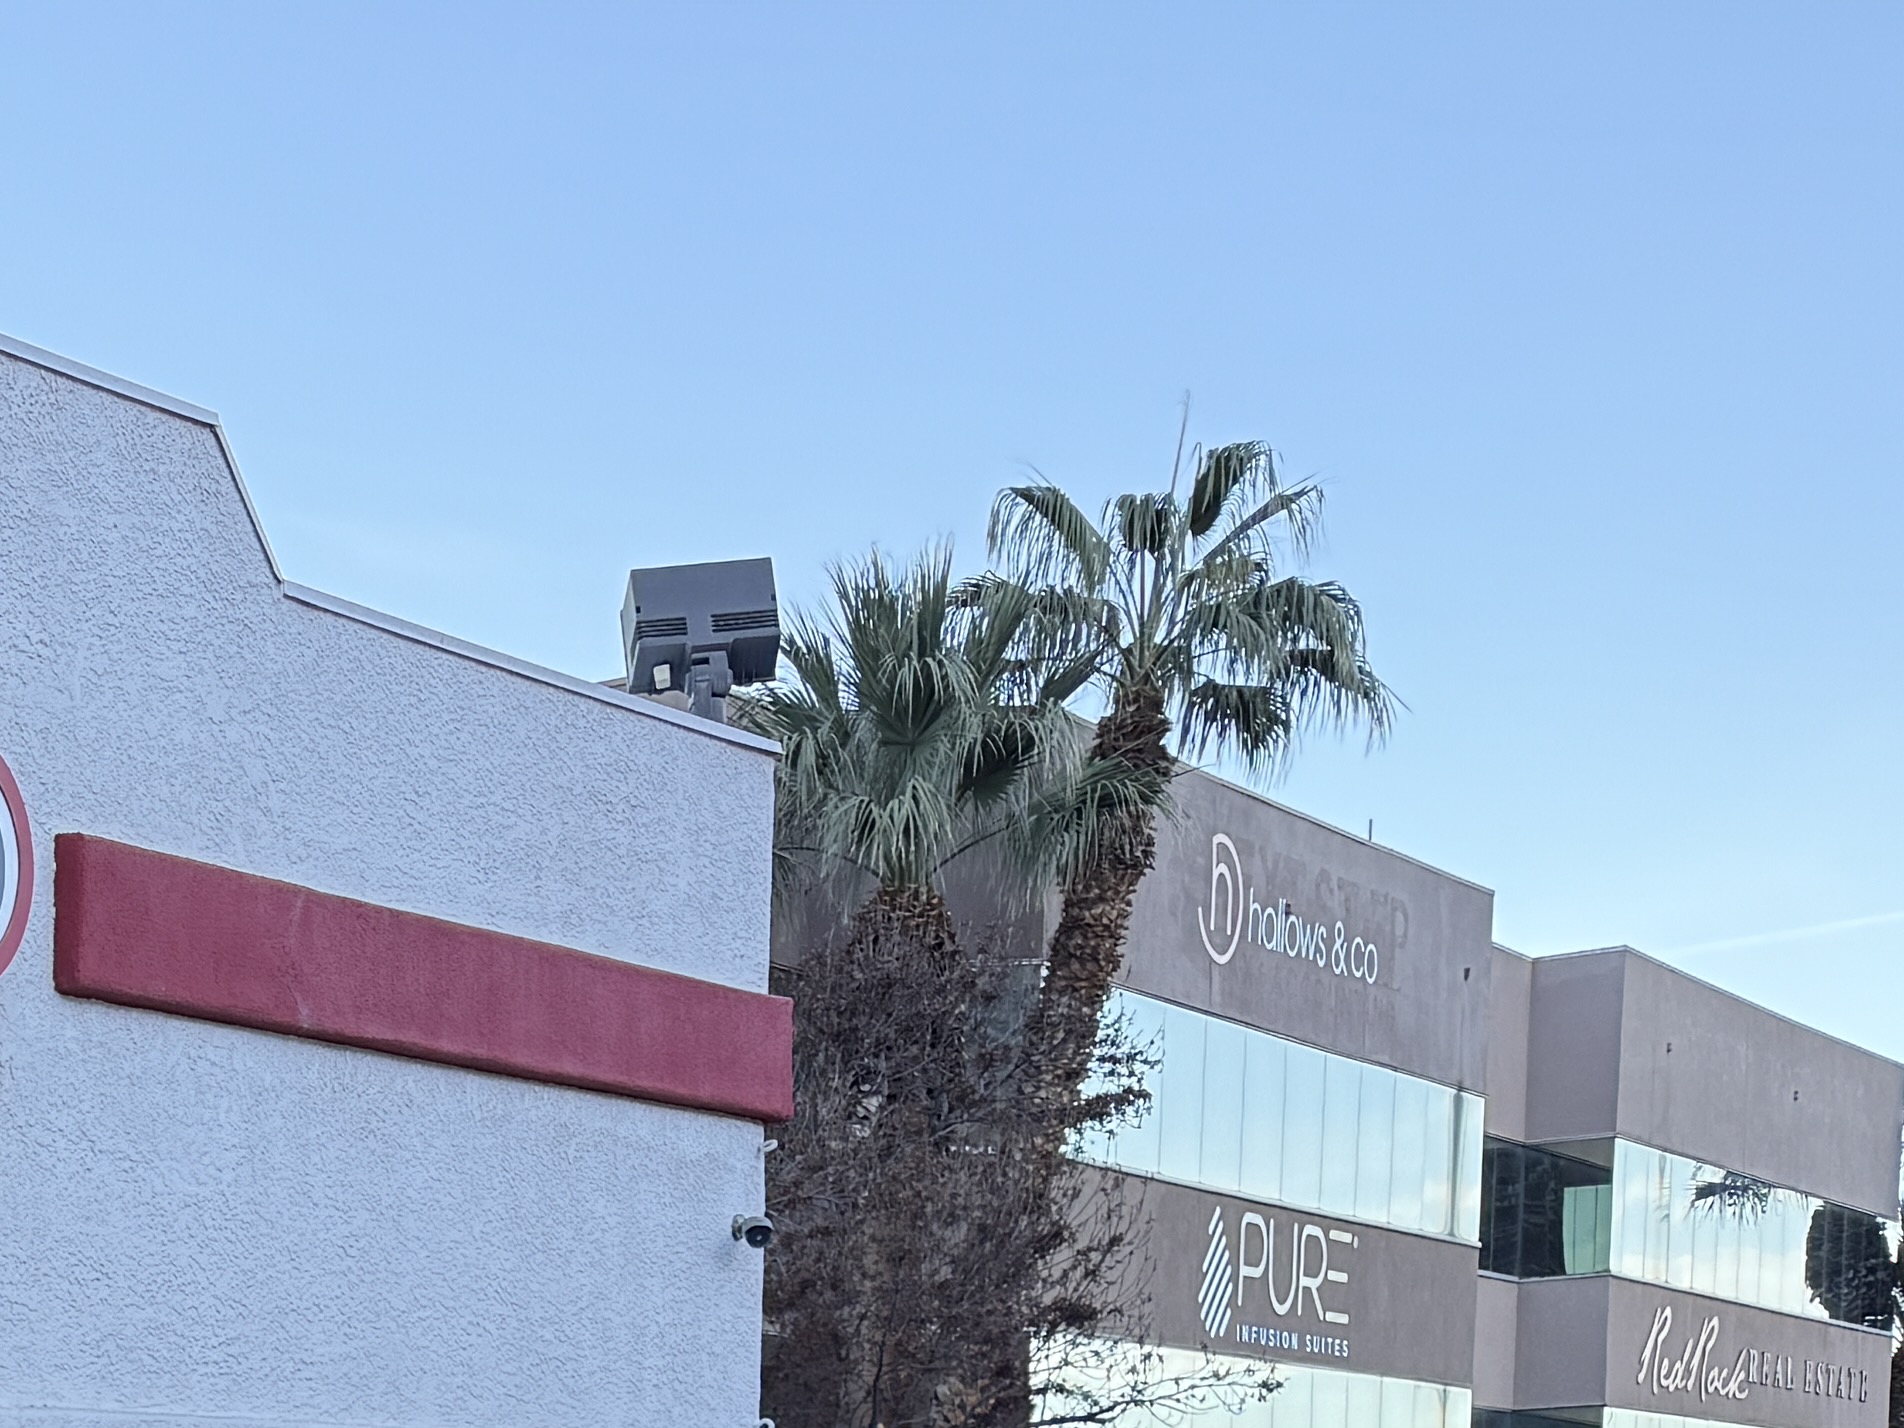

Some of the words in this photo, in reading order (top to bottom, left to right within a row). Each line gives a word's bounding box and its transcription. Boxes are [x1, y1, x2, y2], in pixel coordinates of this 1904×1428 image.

[1248, 886, 1327, 968] hallows
[1331, 920, 1348, 977] &
[1237, 1211, 1354, 1325] PURE
[1235, 1323, 1299, 1350] INFUSION
[1305, 1333, 1349, 1358] SUITES
[1747, 1348, 1795, 1391] REAL
[1803, 1359, 1869, 1403] ESTATE
